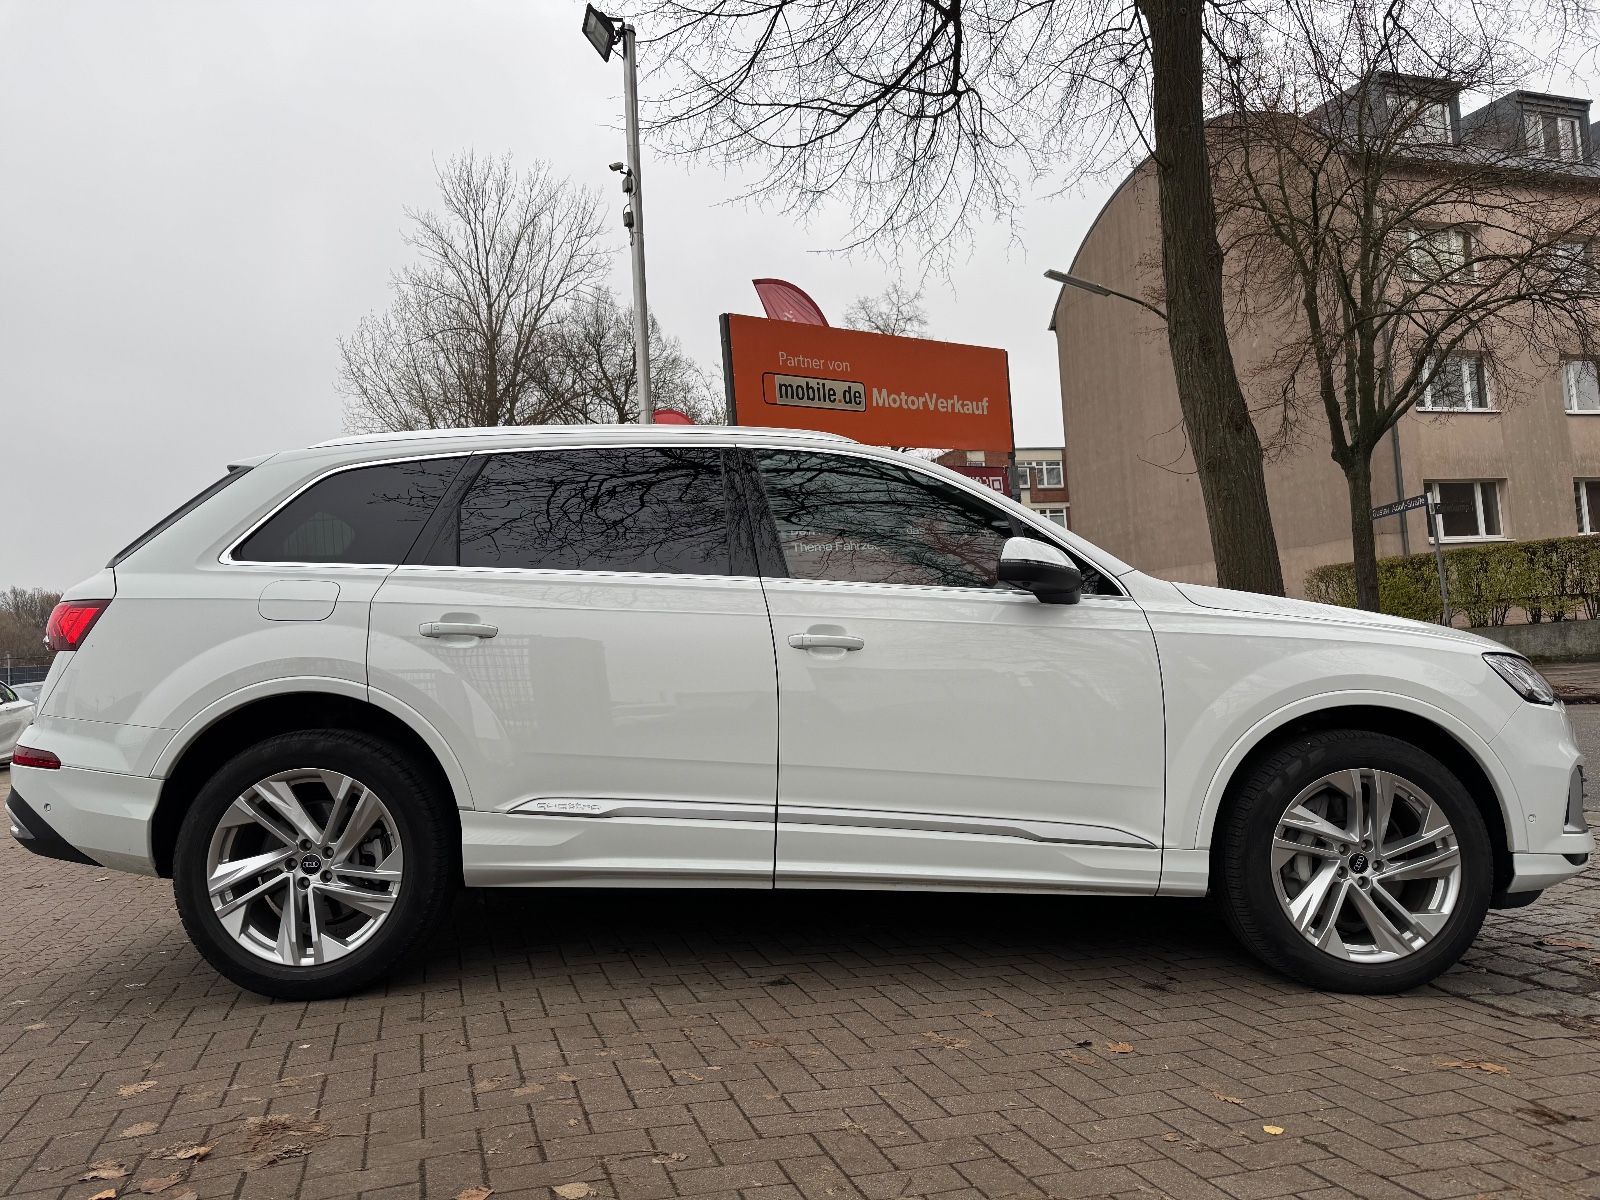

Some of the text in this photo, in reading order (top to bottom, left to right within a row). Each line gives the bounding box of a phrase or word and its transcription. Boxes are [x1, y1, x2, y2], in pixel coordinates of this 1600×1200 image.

[778, 351, 851, 372] Partner von
[778, 381, 863, 406] mobile.de
[872, 387, 989, 415] MotorVerkauf
[793, 542, 833, 553] Thema
